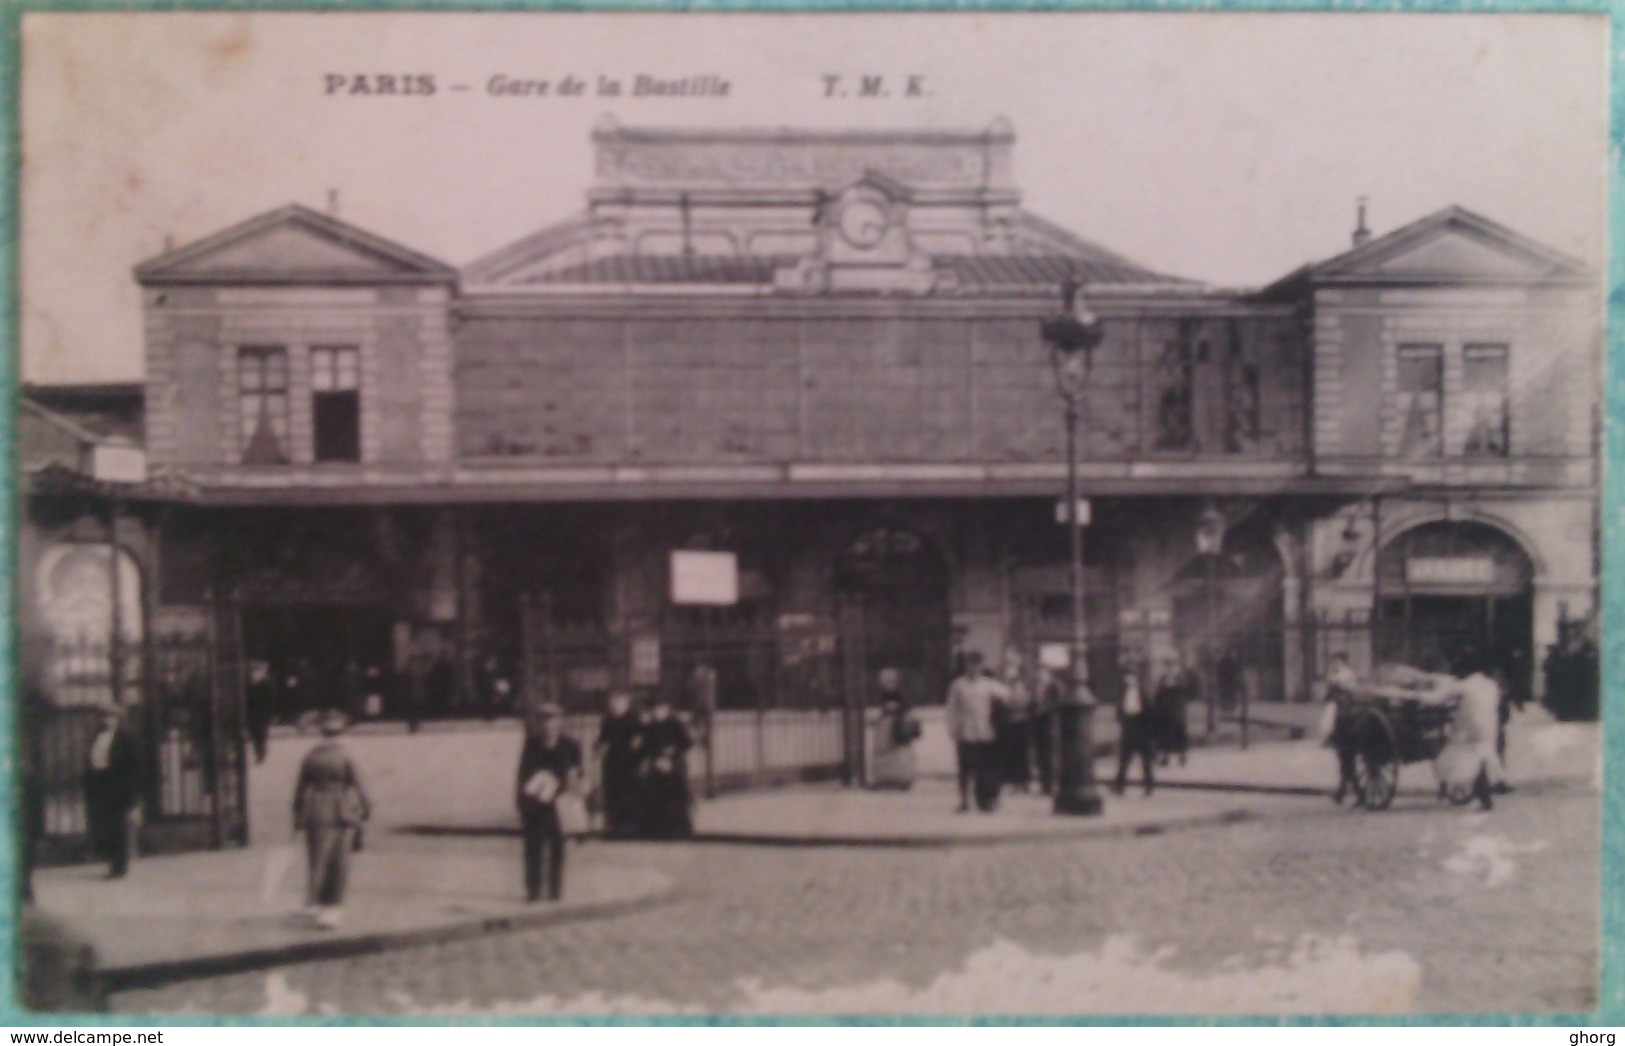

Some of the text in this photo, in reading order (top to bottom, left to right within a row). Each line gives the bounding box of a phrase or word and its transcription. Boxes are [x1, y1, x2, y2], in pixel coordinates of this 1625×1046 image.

[323, 73, 438, 97] PARIS
[486, 73, 550, 97] Gare
[556, 74, 587, 97] de
[597, 74, 622, 97] la
[631, 73, 731, 97] Bastille
